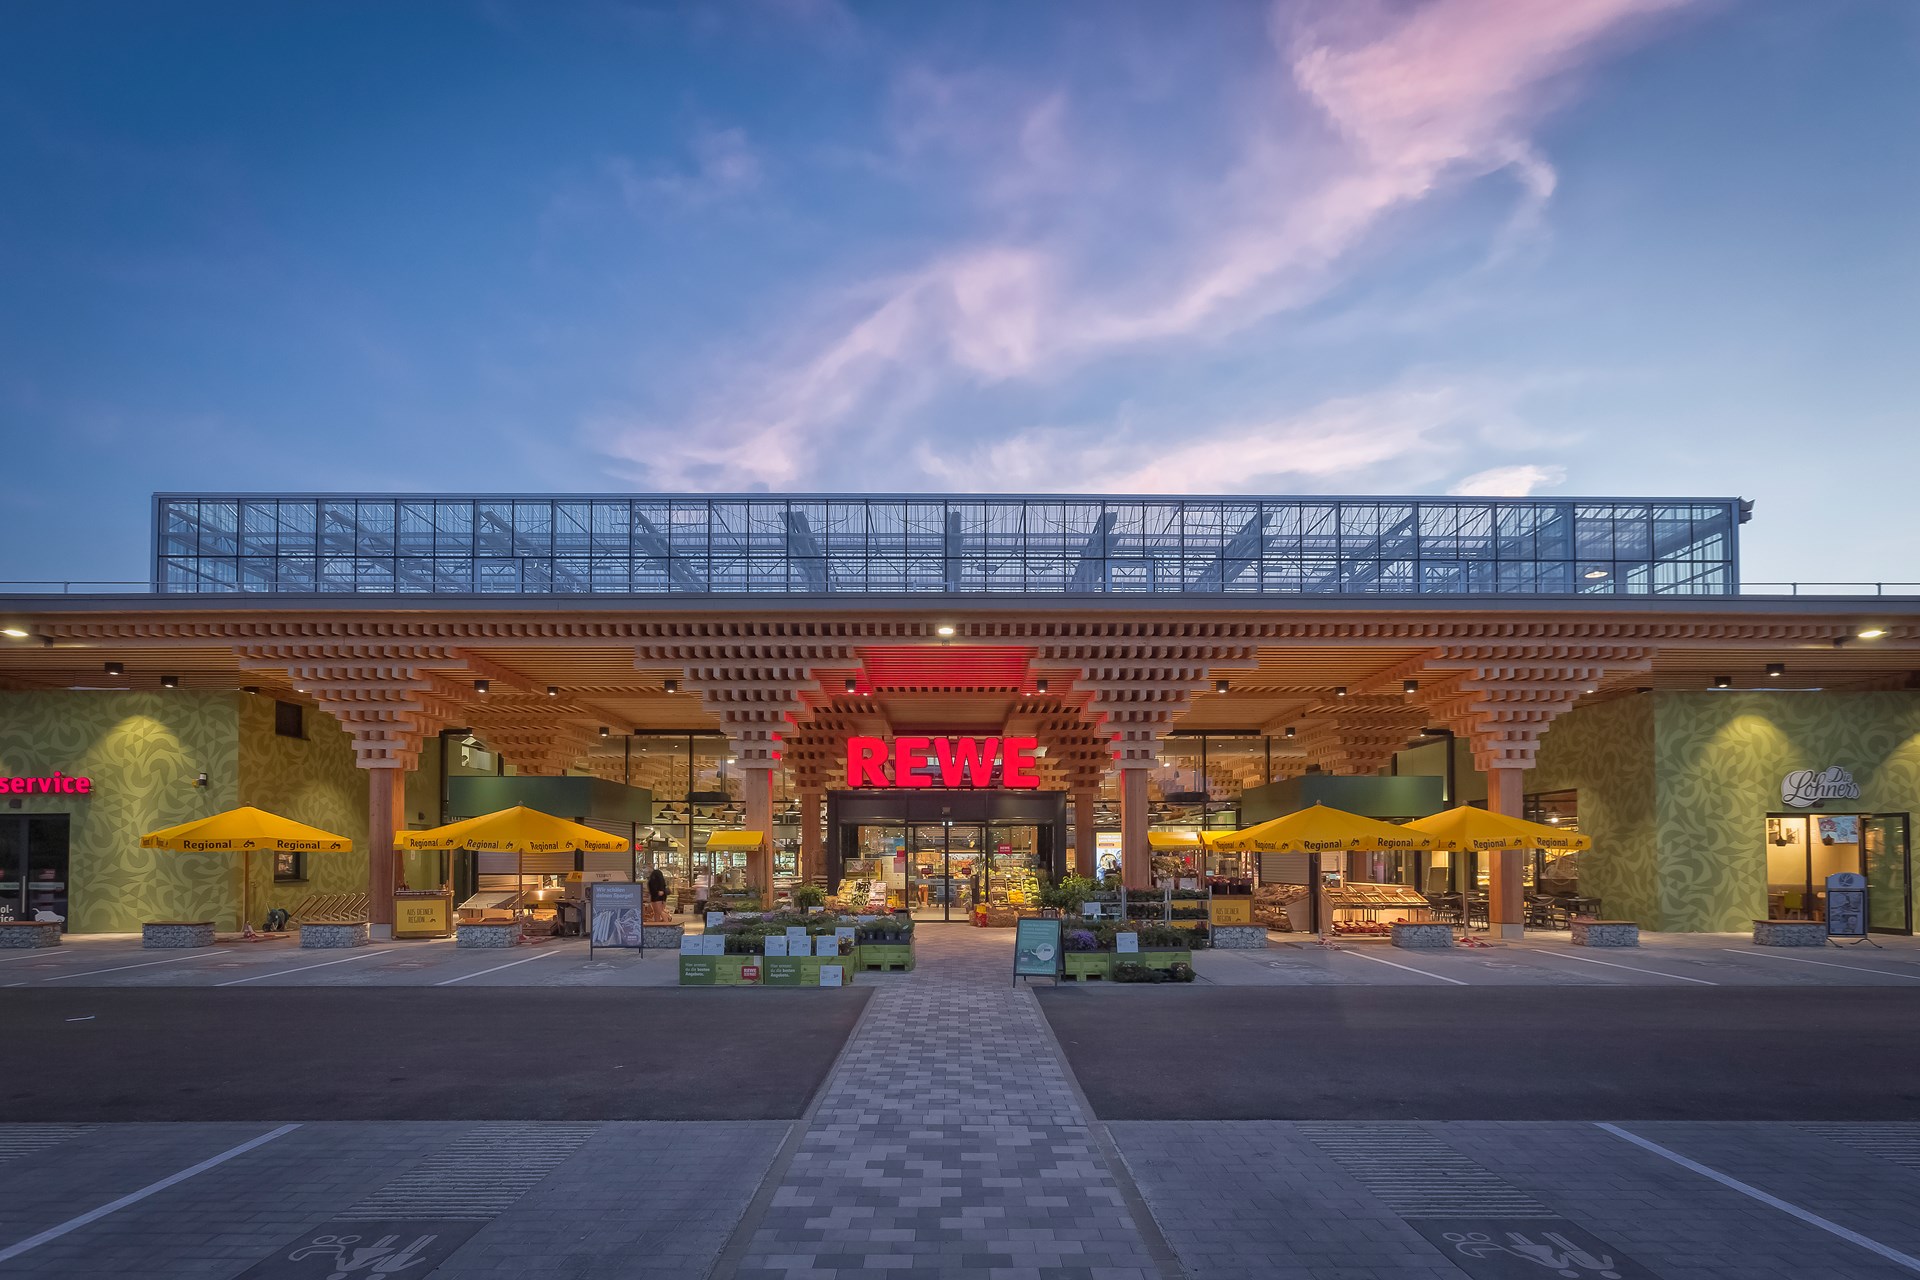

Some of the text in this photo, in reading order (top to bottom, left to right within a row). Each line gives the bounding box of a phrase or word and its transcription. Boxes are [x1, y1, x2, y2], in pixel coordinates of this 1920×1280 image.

[847, 737, 1040, 788] REWE
[1828, 767, 1852, 783] Die
[0, 771, 90, 794] service
[1783, 771, 1859, 802] Lohners
[184, 840, 231, 851] Regional
[277, 840, 320, 850] Regional
[410, 838, 438, 849] Regional
[466, 838, 498, 850] Regional
[530, 841, 558, 852] Regional
[584, 840, 610, 850] Regional
[1304, 839, 1342, 851] Regional
[1377, 838, 1413, 849] Regional
[1473, 839, 1506, 850] Regional
[1536, 837, 1568, 848] Regional
